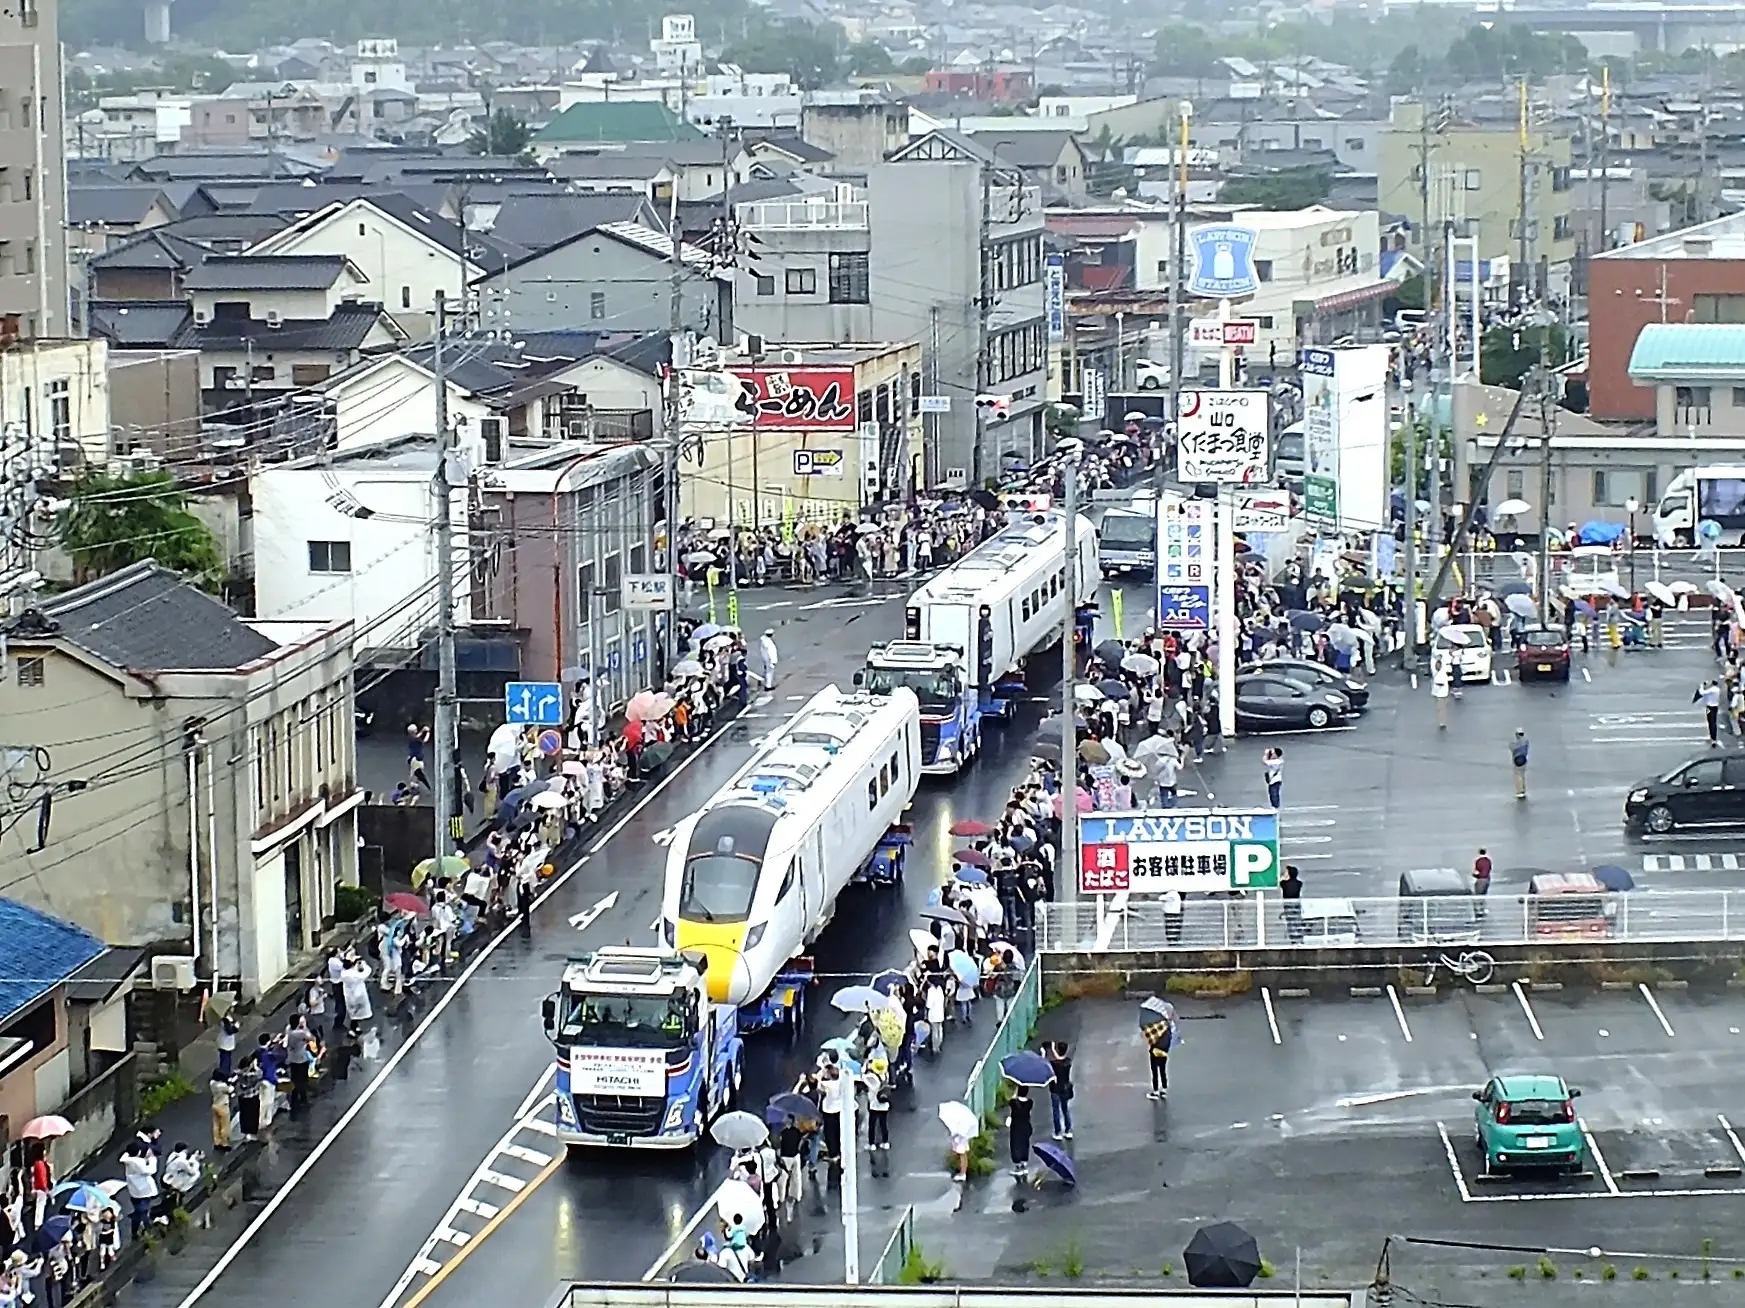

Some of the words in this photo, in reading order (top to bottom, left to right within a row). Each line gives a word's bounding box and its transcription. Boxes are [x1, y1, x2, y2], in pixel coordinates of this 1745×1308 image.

[1210, 411, 1235, 427] 山口
[1180, 427, 1264, 460] くだまつ食堂
[797, 455, 810, 470] P
[628, 581, 666, 593] 下松駅
[1165, 608, 1191, 620] 入口
[1104, 816, 1253, 842] LAWSON
[1096, 848, 1116, 868] 酒
[1132, 854, 1228, 877] お客様駐車場
[1234, 844, 1273, 885] P
[1084, 870, 1128, 887] たばこ
[596, 1076, 640, 1085] HITACHI
